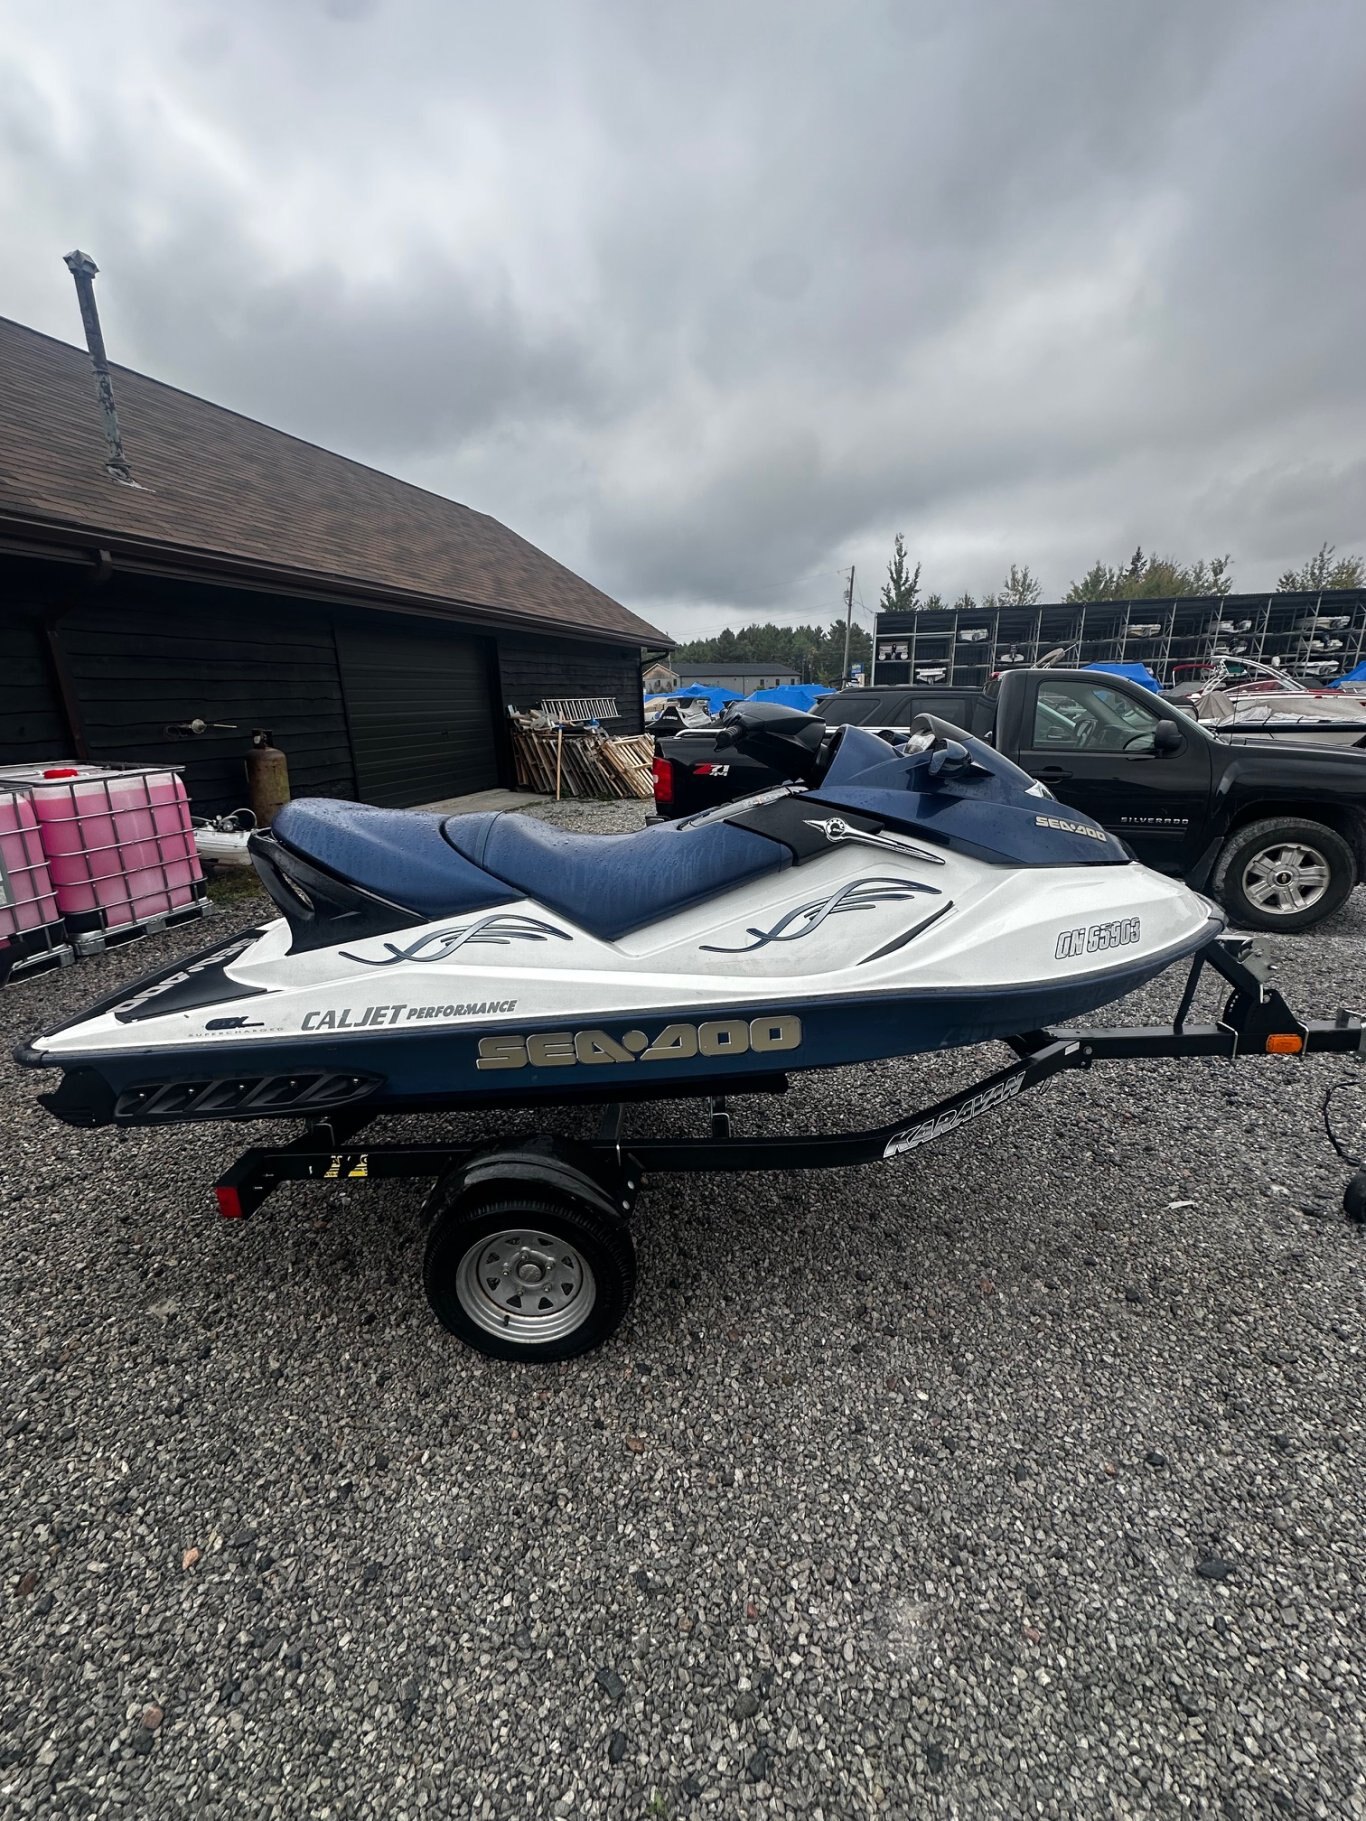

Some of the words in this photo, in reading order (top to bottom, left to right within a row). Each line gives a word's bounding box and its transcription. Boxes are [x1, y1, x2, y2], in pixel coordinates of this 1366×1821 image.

[1121, 816, 1189, 825] SILVERADO
[1055, 927, 1086, 959] ON
[1087, 916, 1140, 953] 65903
[406, 1000, 517, 1020] PERFORMANCE
[883, 1070, 1027, 1159] KARAVAN
